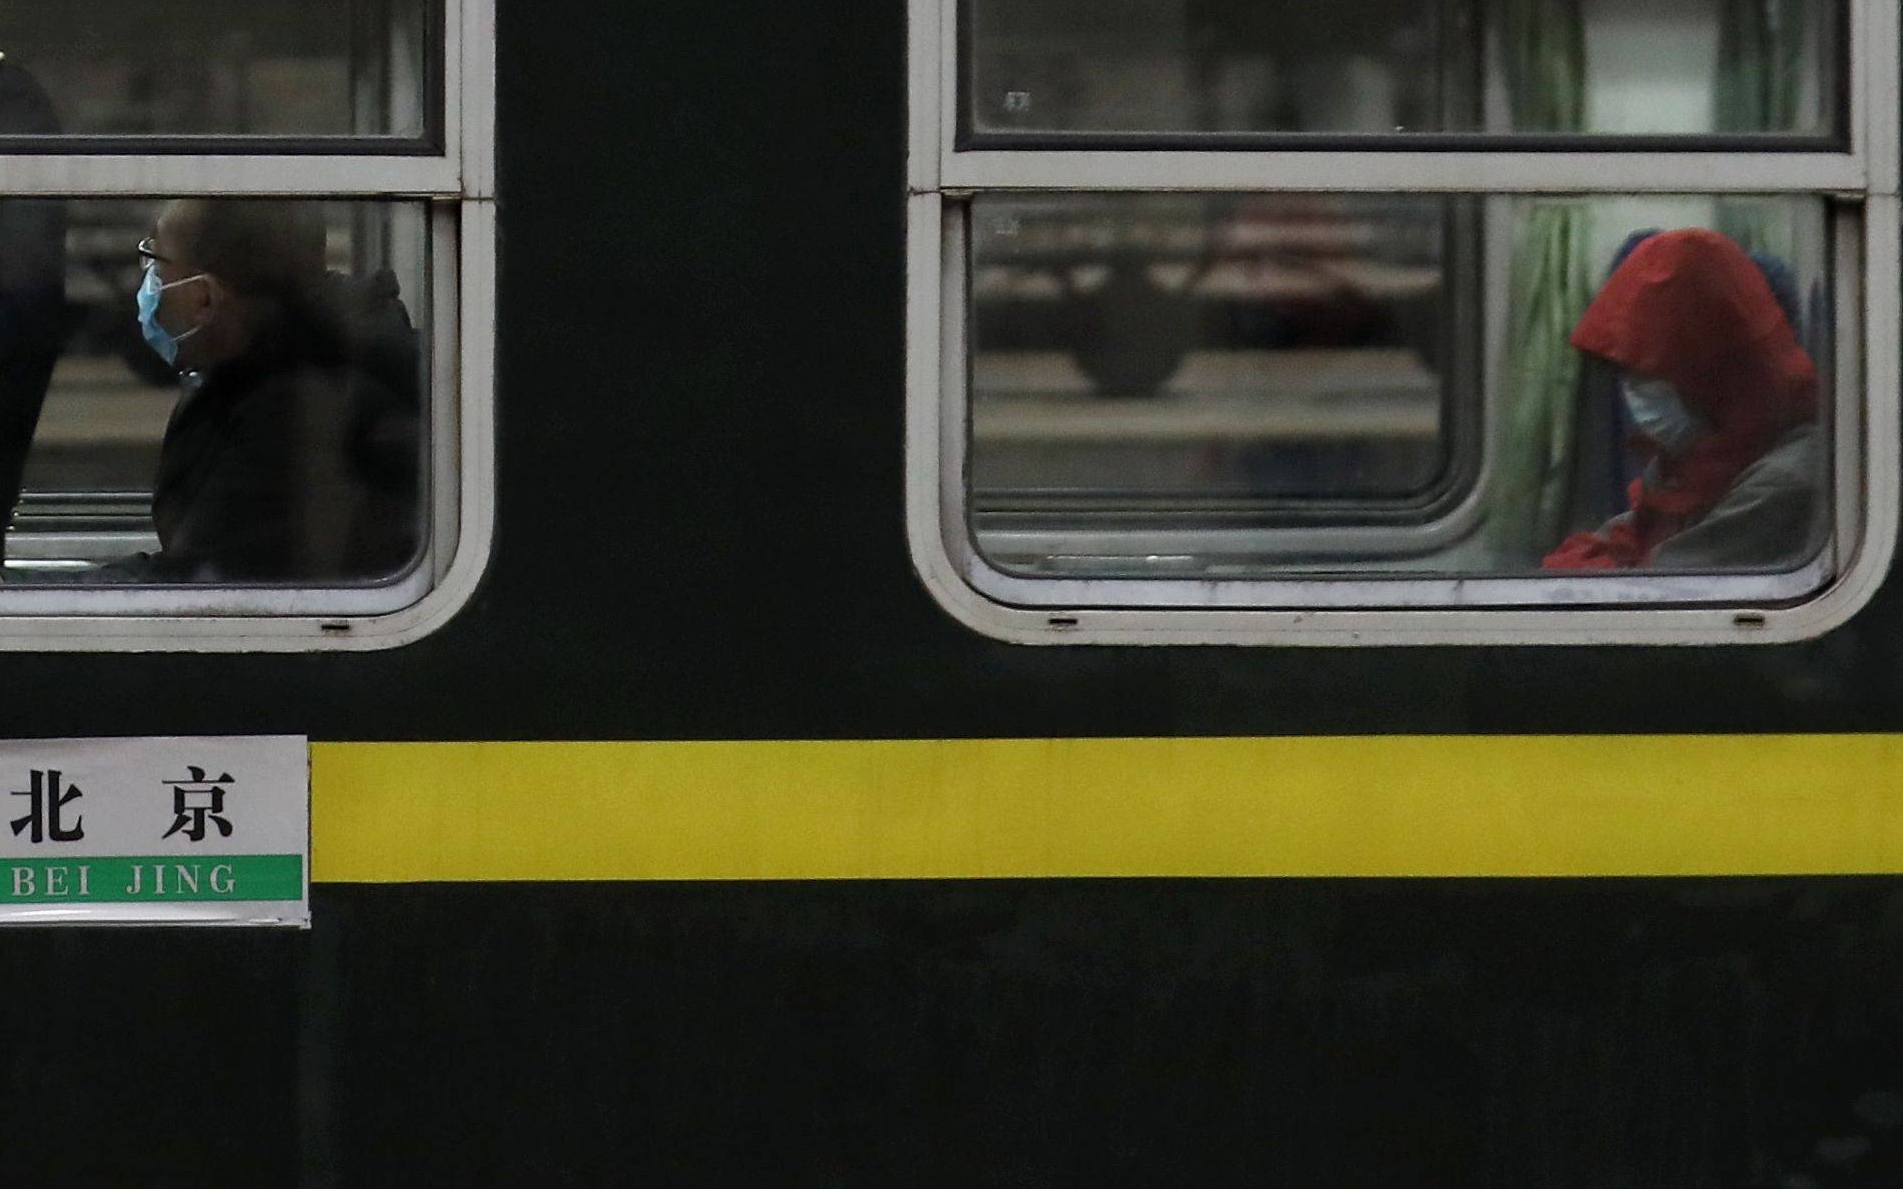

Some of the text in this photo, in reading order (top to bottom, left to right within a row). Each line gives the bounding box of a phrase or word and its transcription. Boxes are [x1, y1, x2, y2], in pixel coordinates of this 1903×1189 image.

[9, 765, 236, 844] 北京
[10, 862, 236, 898] BEI JING
